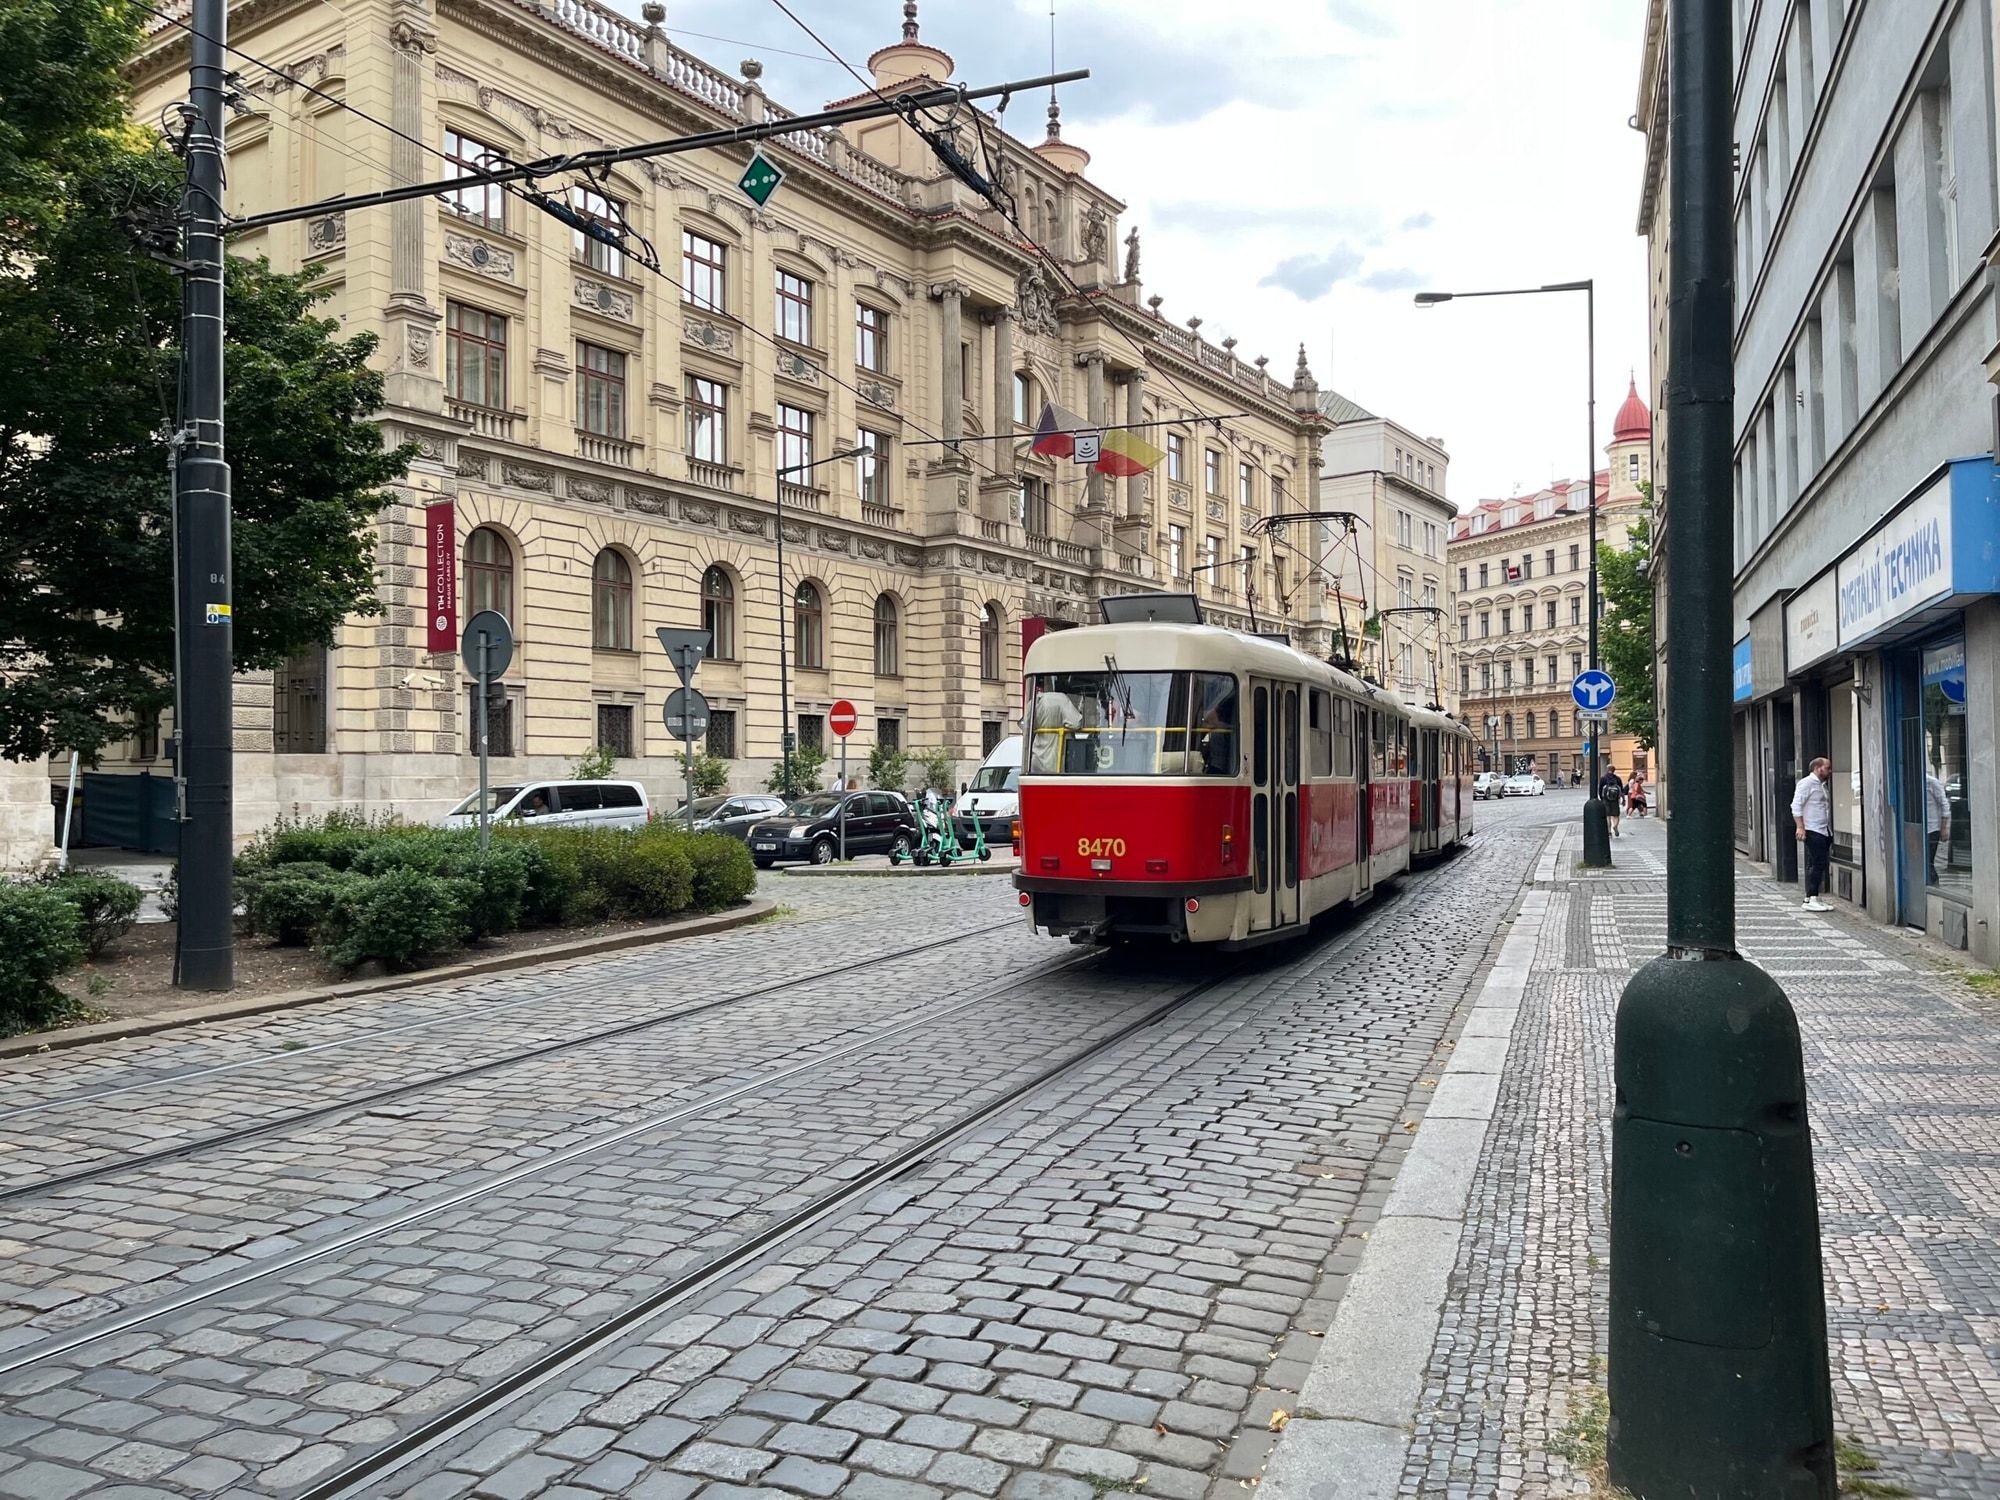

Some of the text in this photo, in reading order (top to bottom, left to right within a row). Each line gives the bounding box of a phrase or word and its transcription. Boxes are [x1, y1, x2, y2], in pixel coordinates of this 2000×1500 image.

[437, 524, 445, 593] COLLECTION
[210, 573, 225, 584] 84
[1841, 517, 1941, 628] DIGITÁLNÍ TECHNIKA
[1097, 745, 1114, 769] 9
[1078, 838, 1126, 857] 8470
